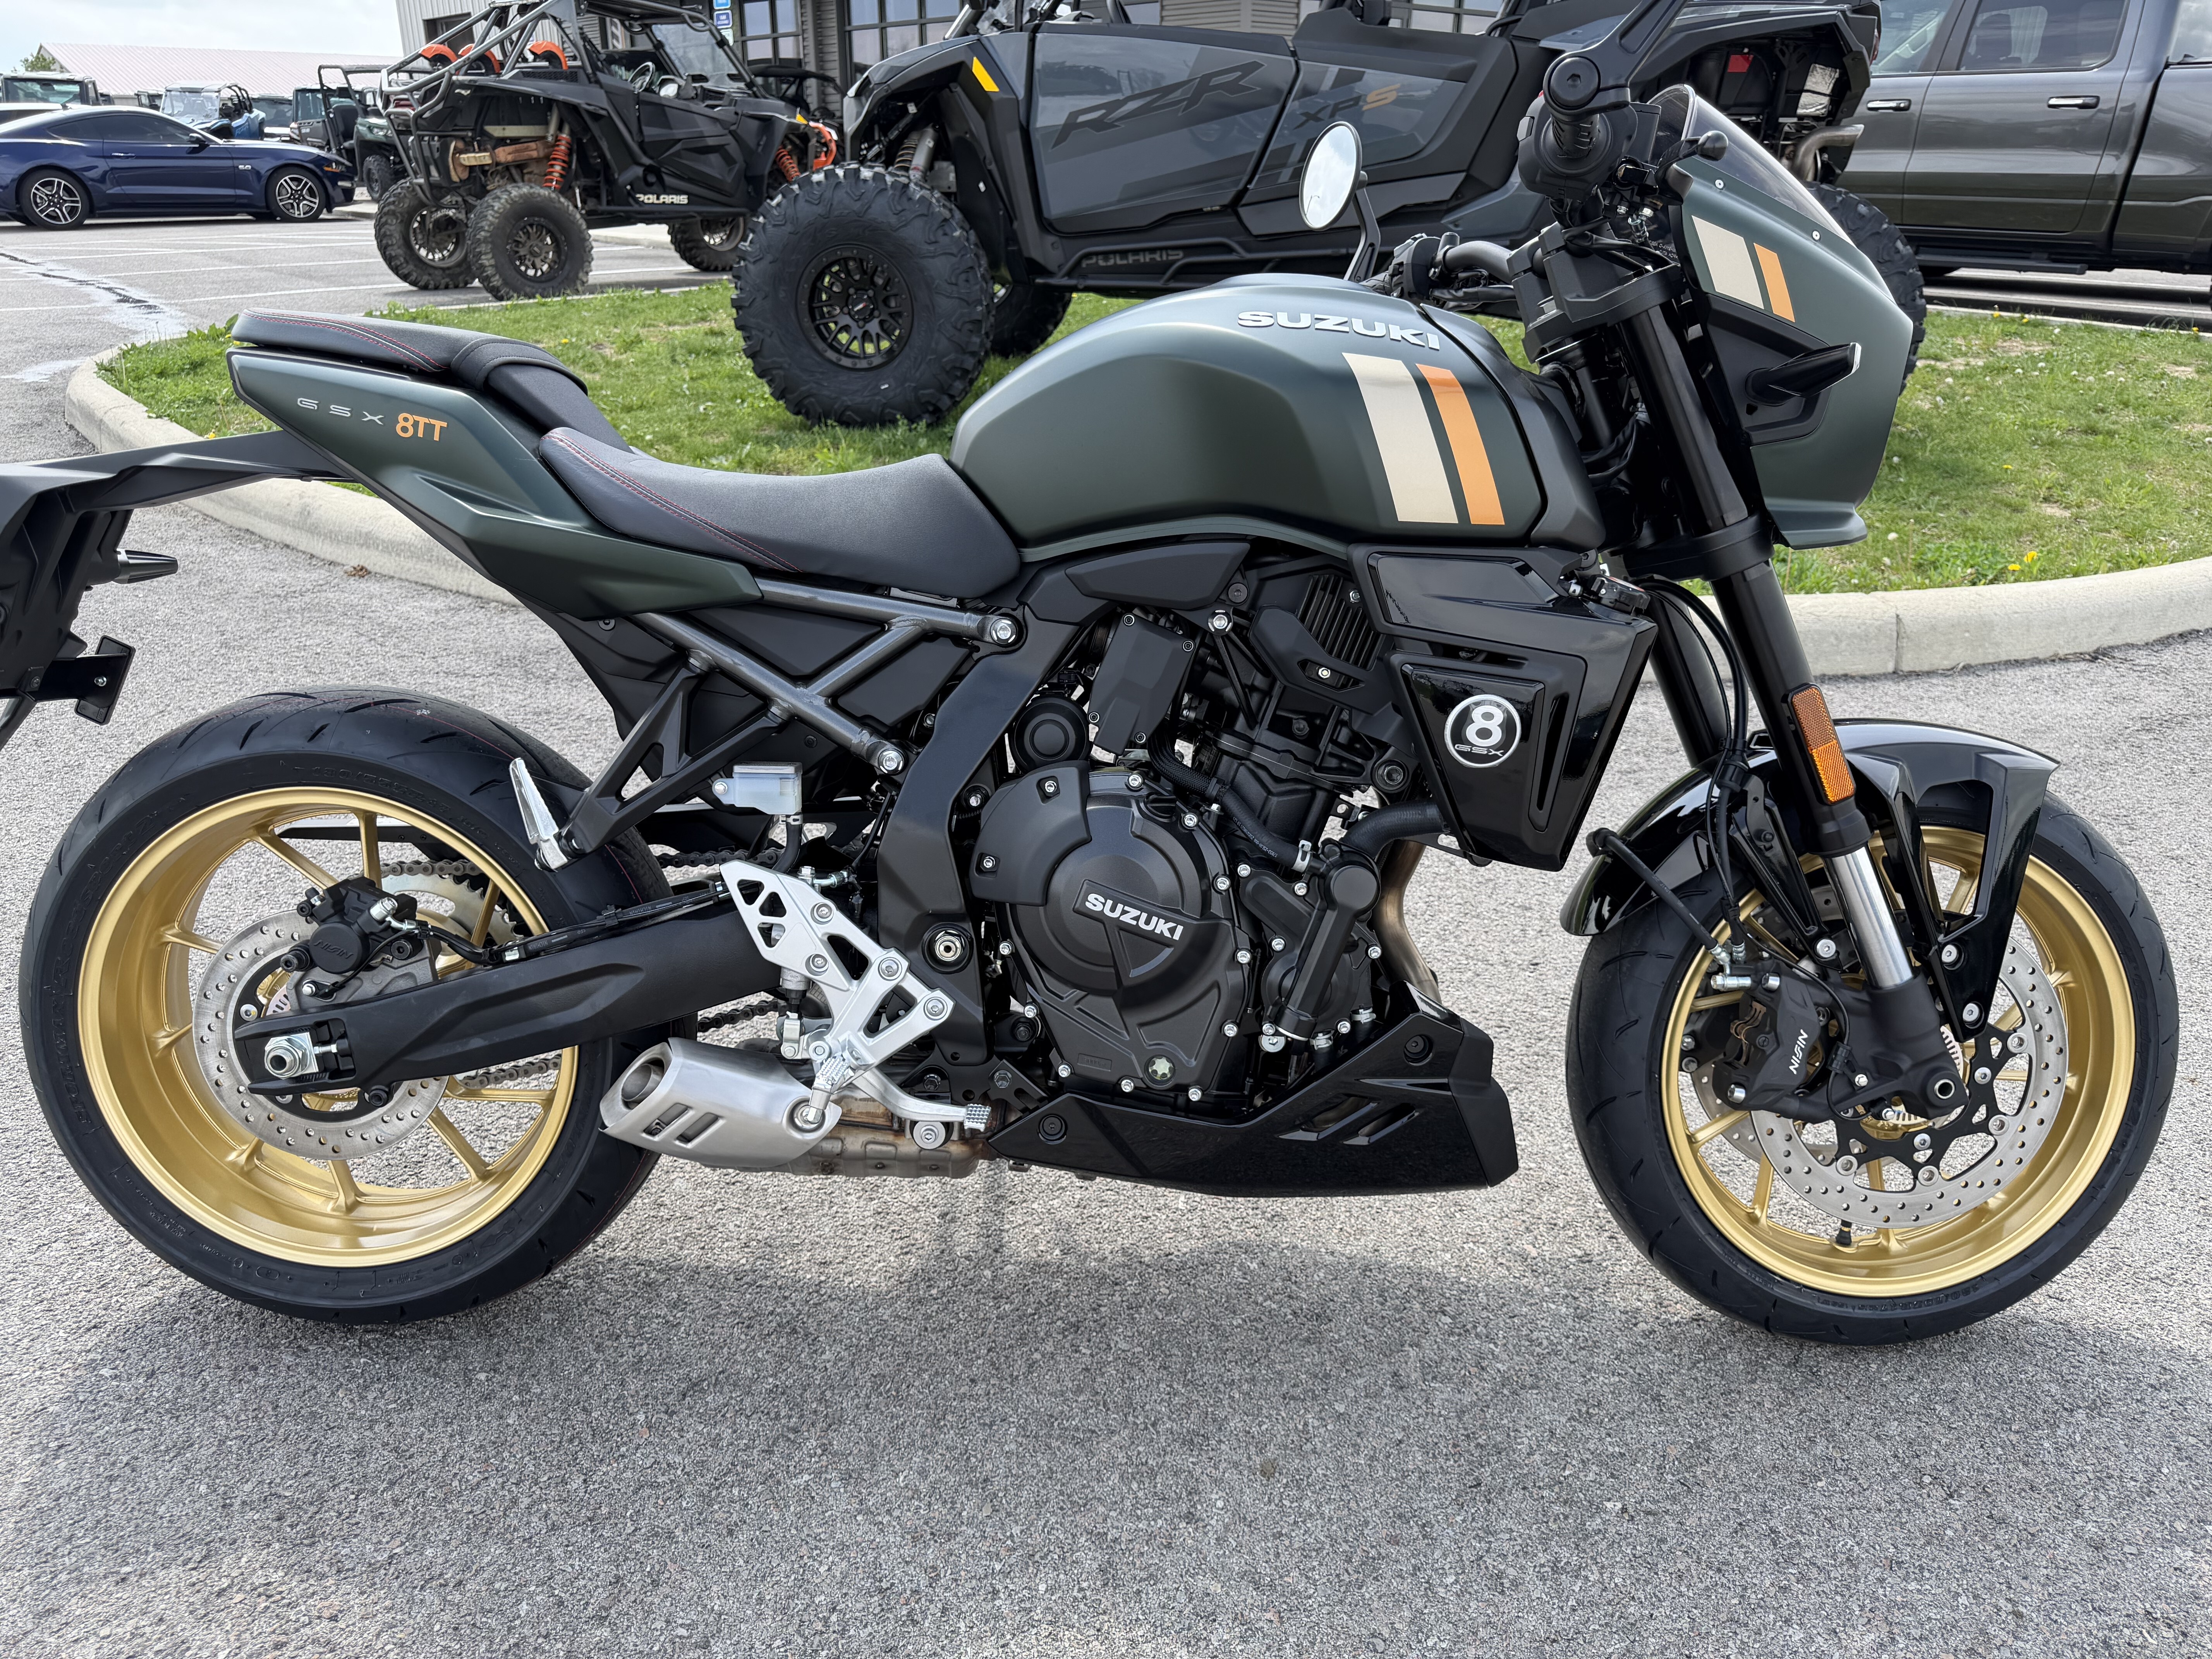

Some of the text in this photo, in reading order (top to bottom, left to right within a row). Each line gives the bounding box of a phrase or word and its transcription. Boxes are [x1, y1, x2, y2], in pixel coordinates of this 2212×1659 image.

[1051, 60, 1267, 150] RZR
[635, 194, 689, 204] POLARIS
[1237, 310, 1440, 351] SUZUKI
[395, 412, 447, 441] 8TT
[1466, 705, 1502, 746] 8
[1454, 744, 1504, 757] GSX
[1085, 893, 1184, 941] SUZUKI
